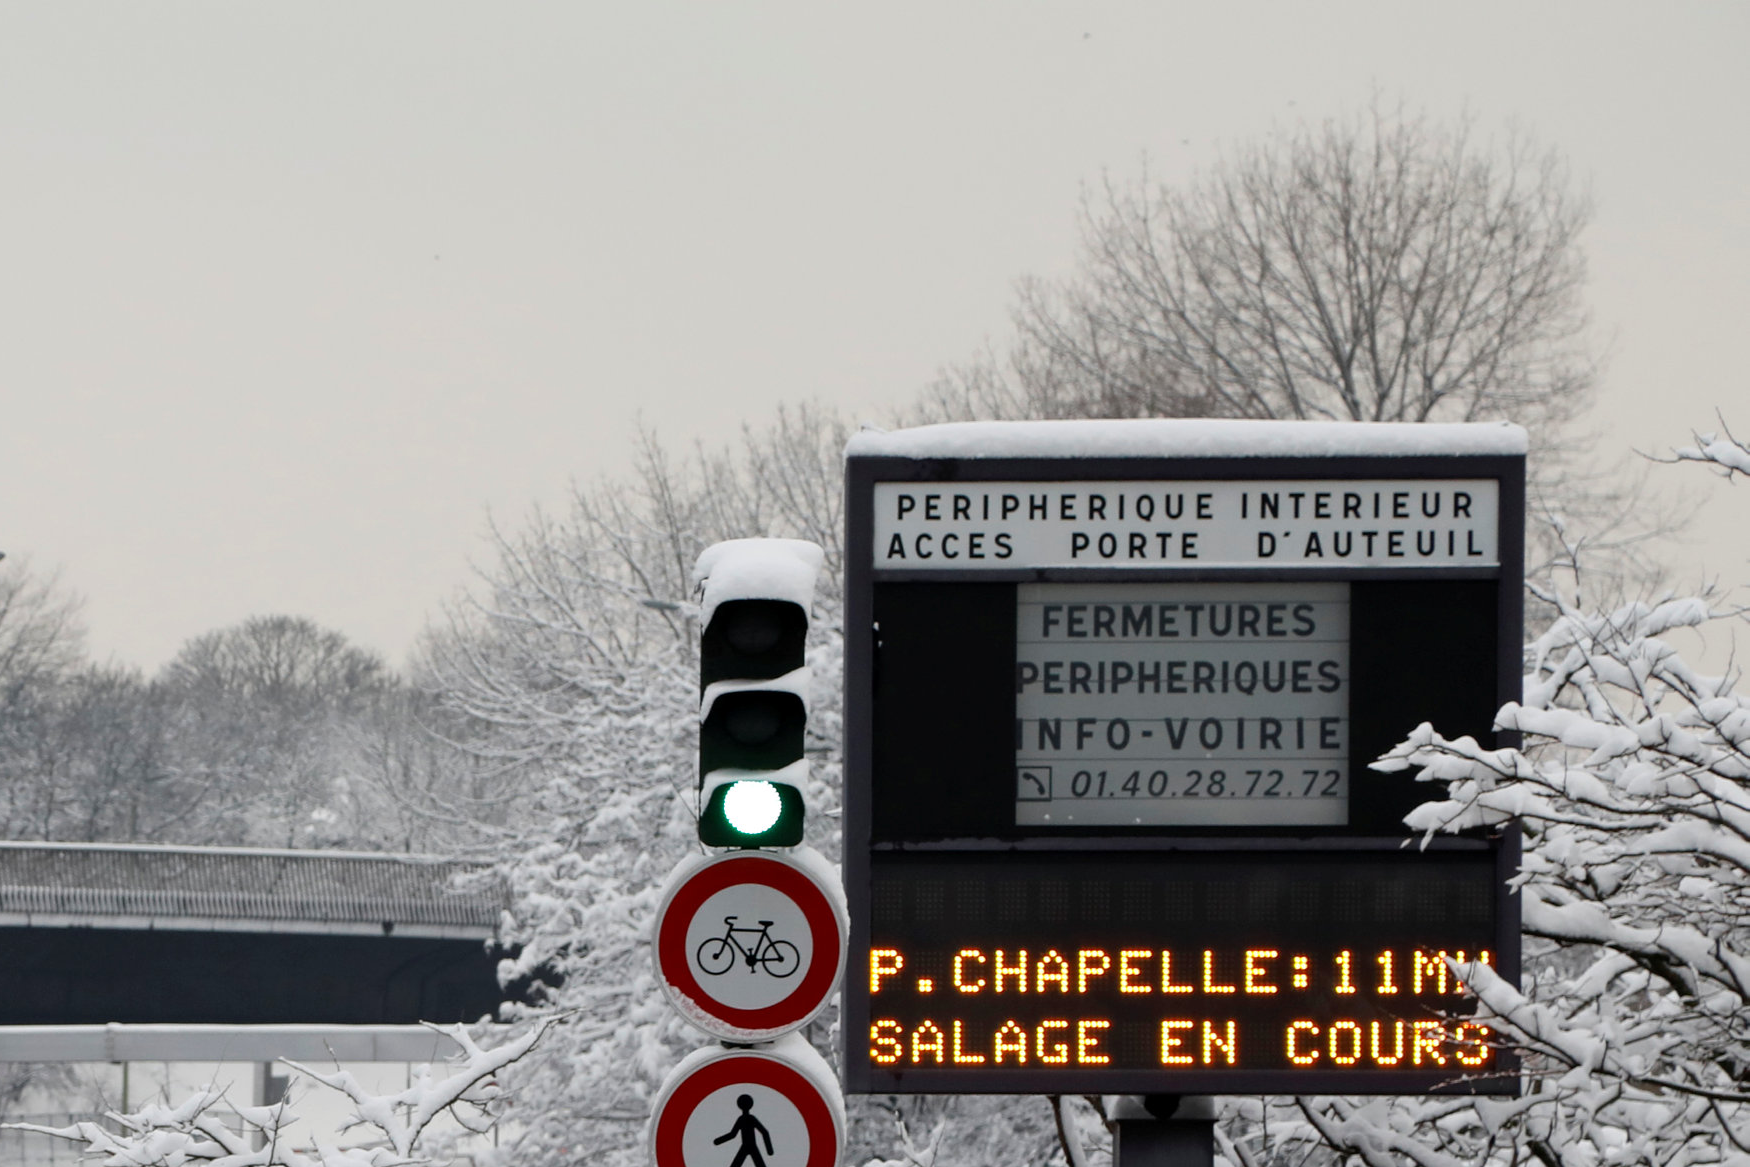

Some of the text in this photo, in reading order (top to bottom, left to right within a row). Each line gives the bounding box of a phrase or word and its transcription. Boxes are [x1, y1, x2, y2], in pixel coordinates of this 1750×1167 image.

[897, 492, 1473, 523] PERIPHERIQUE INTERIEUR
[888, 533, 1014, 560] ACCES
[1071, 532, 1199, 559] PORTE
[1042, 604, 1316, 638] FERMETURES
[1017, 660, 1341, 695] PERIPHERIQUES
[1017, 717, 1341, 751] INFO-VOIRIE
[1071, 770, 1341, 797] 01.40.28.72.72
[871, 1020, 1490, 1065] SALAGE EN COURS
